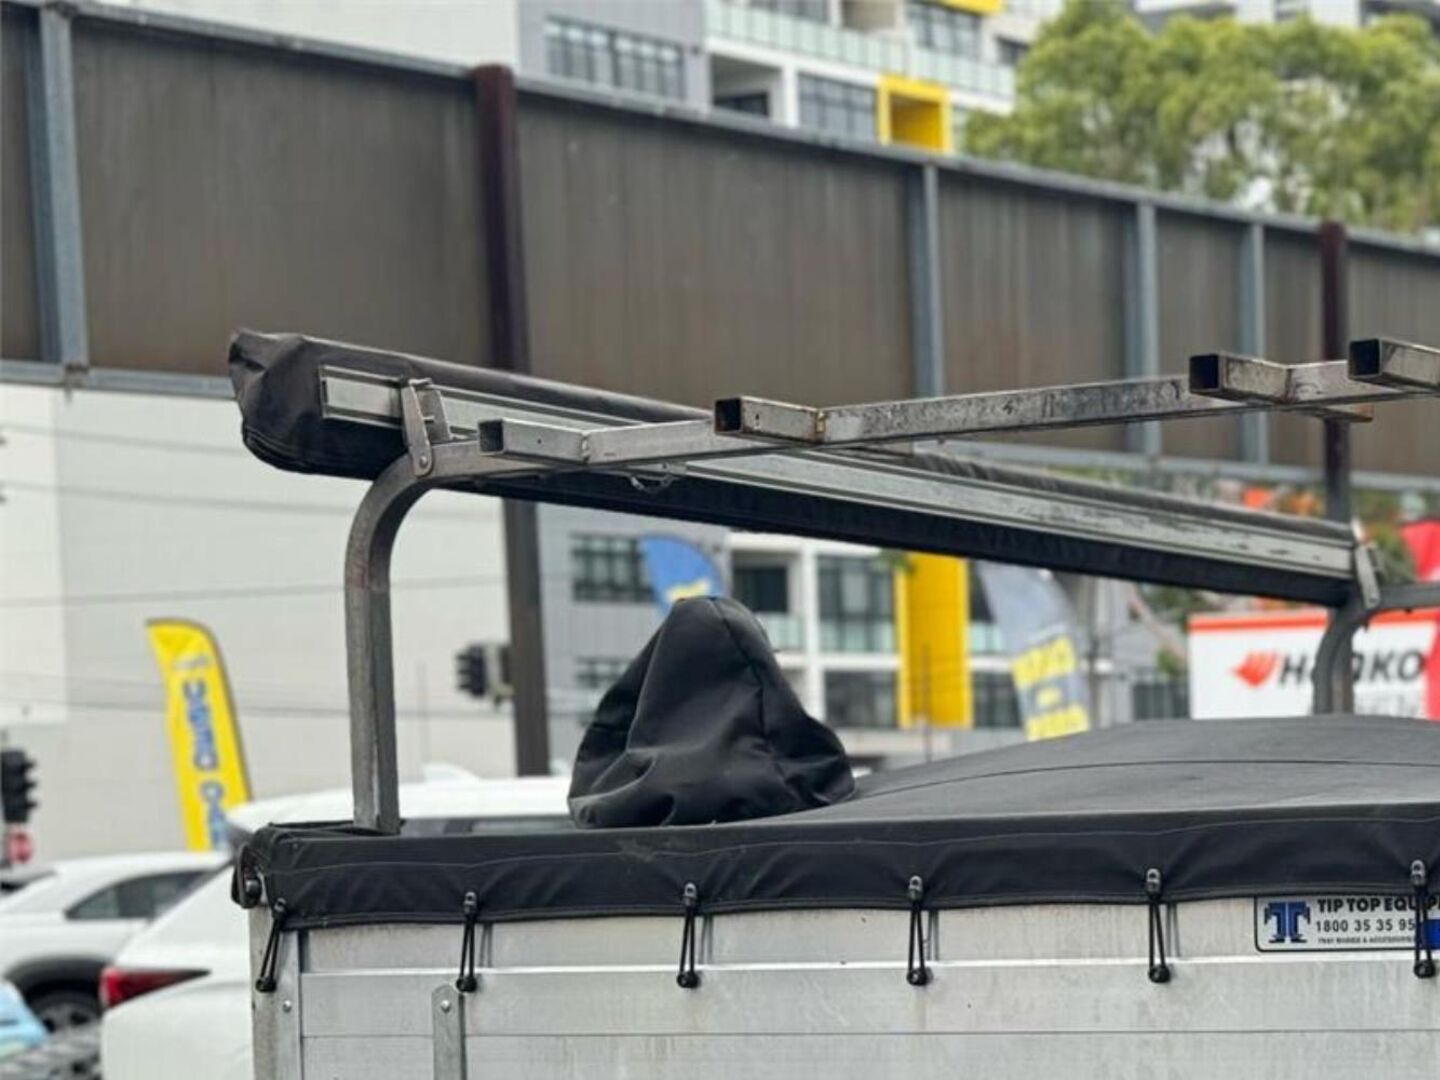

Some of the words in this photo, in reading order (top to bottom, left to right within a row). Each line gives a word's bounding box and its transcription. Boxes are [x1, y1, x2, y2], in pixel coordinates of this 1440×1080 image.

[1317, 898, 1344, 913] TIP
[1347, 897, 1380, 912] TOP
[1316, 920, 1349, 932] 1800
[1354, 919, 1371, 931] 35
[1376, 919, 1393, 931] 35
[1398, 918, 1416, 931] 95
